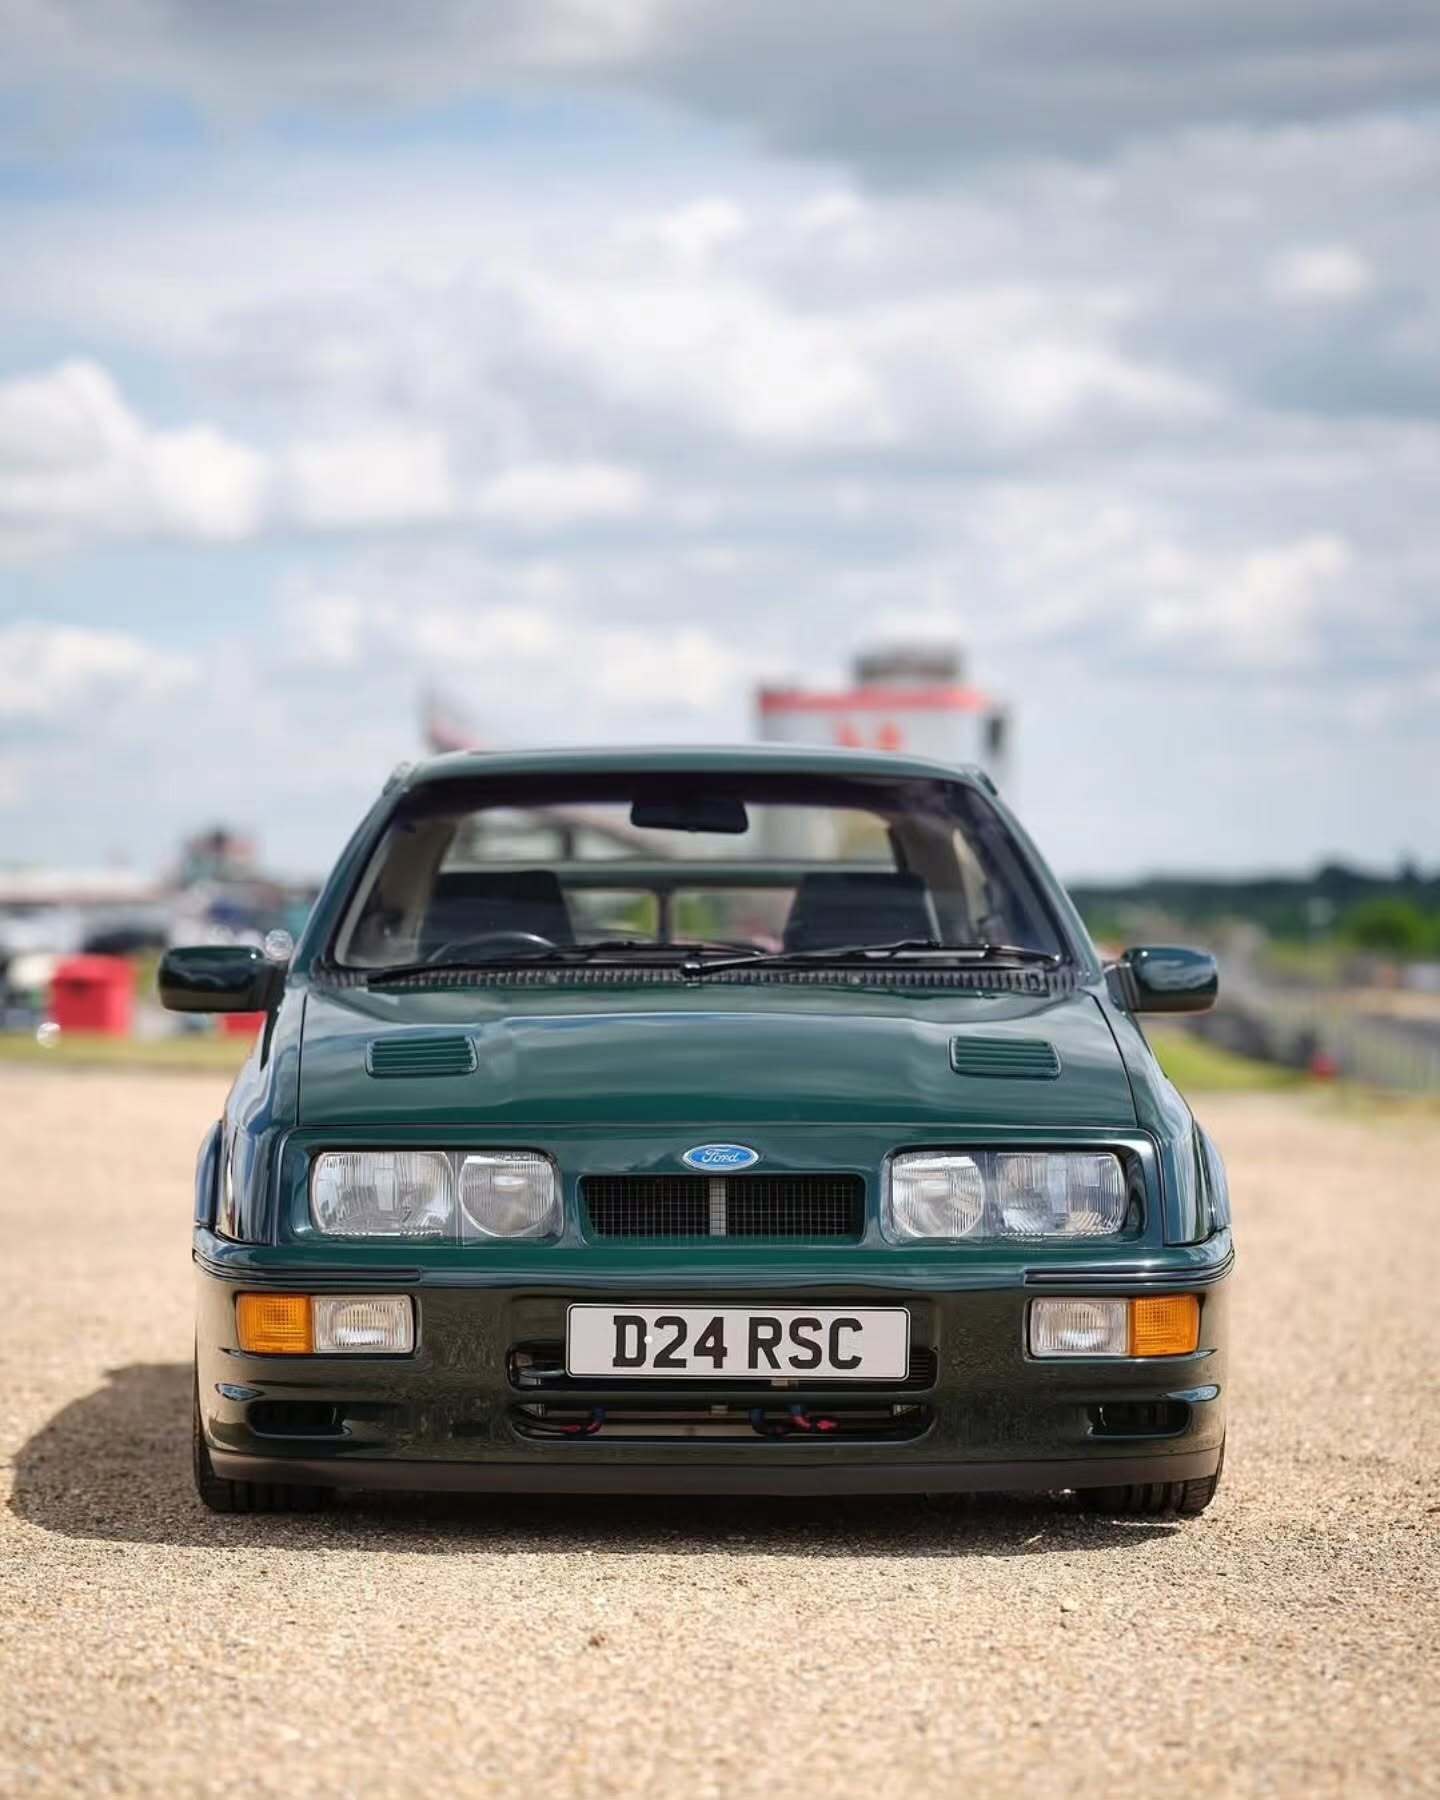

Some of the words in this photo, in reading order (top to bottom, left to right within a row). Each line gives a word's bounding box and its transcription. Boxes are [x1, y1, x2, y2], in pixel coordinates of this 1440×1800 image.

[701, 1148, 740, 1163] Ford
[612, 1315, 728, 1369] D24
[748, 1316, 863, 1370] RSC
